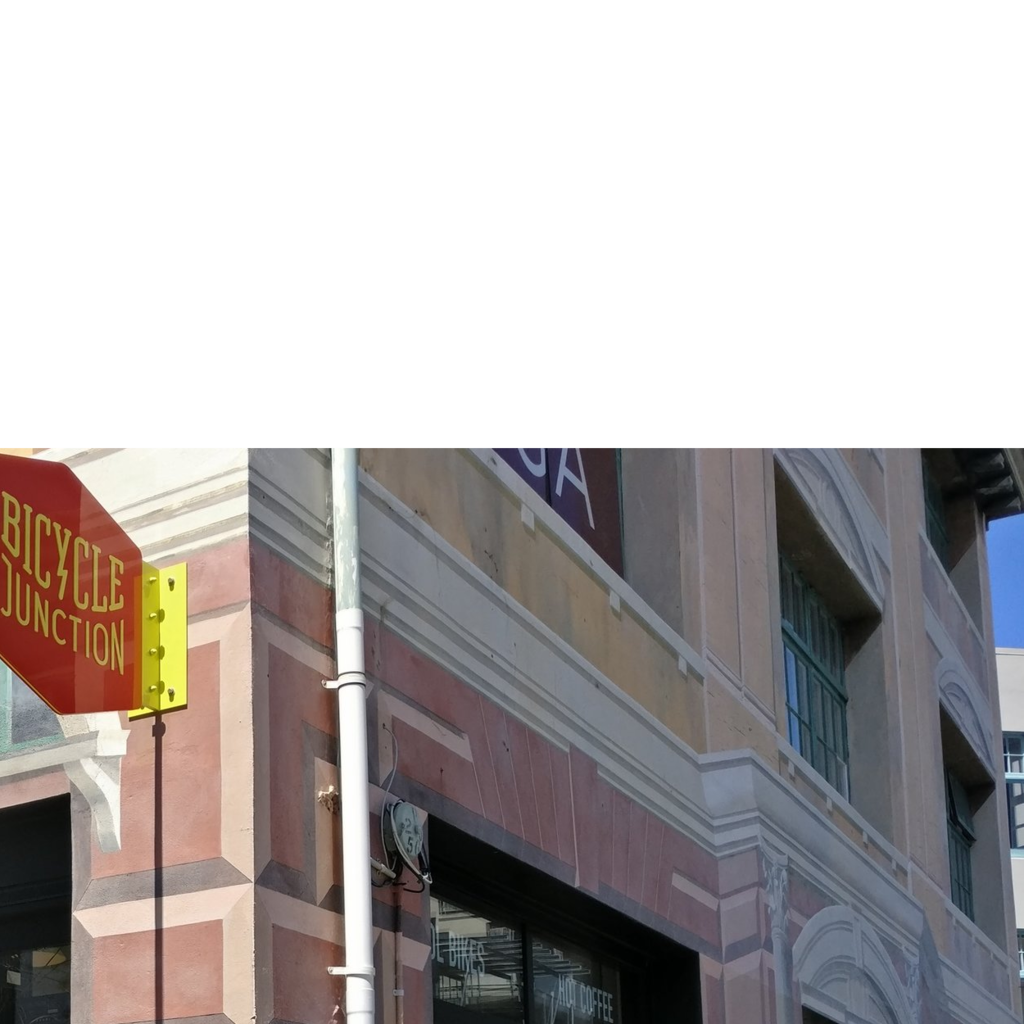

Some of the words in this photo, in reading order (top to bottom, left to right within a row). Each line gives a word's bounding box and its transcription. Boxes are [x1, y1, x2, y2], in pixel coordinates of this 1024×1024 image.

[1, 491, 124, 612] BICYCLE
[0, 552, 124, 676] JUNCTION
[448, 931, 485, 977] BIKES
[580, 984, 614, 1024] COFFEE
